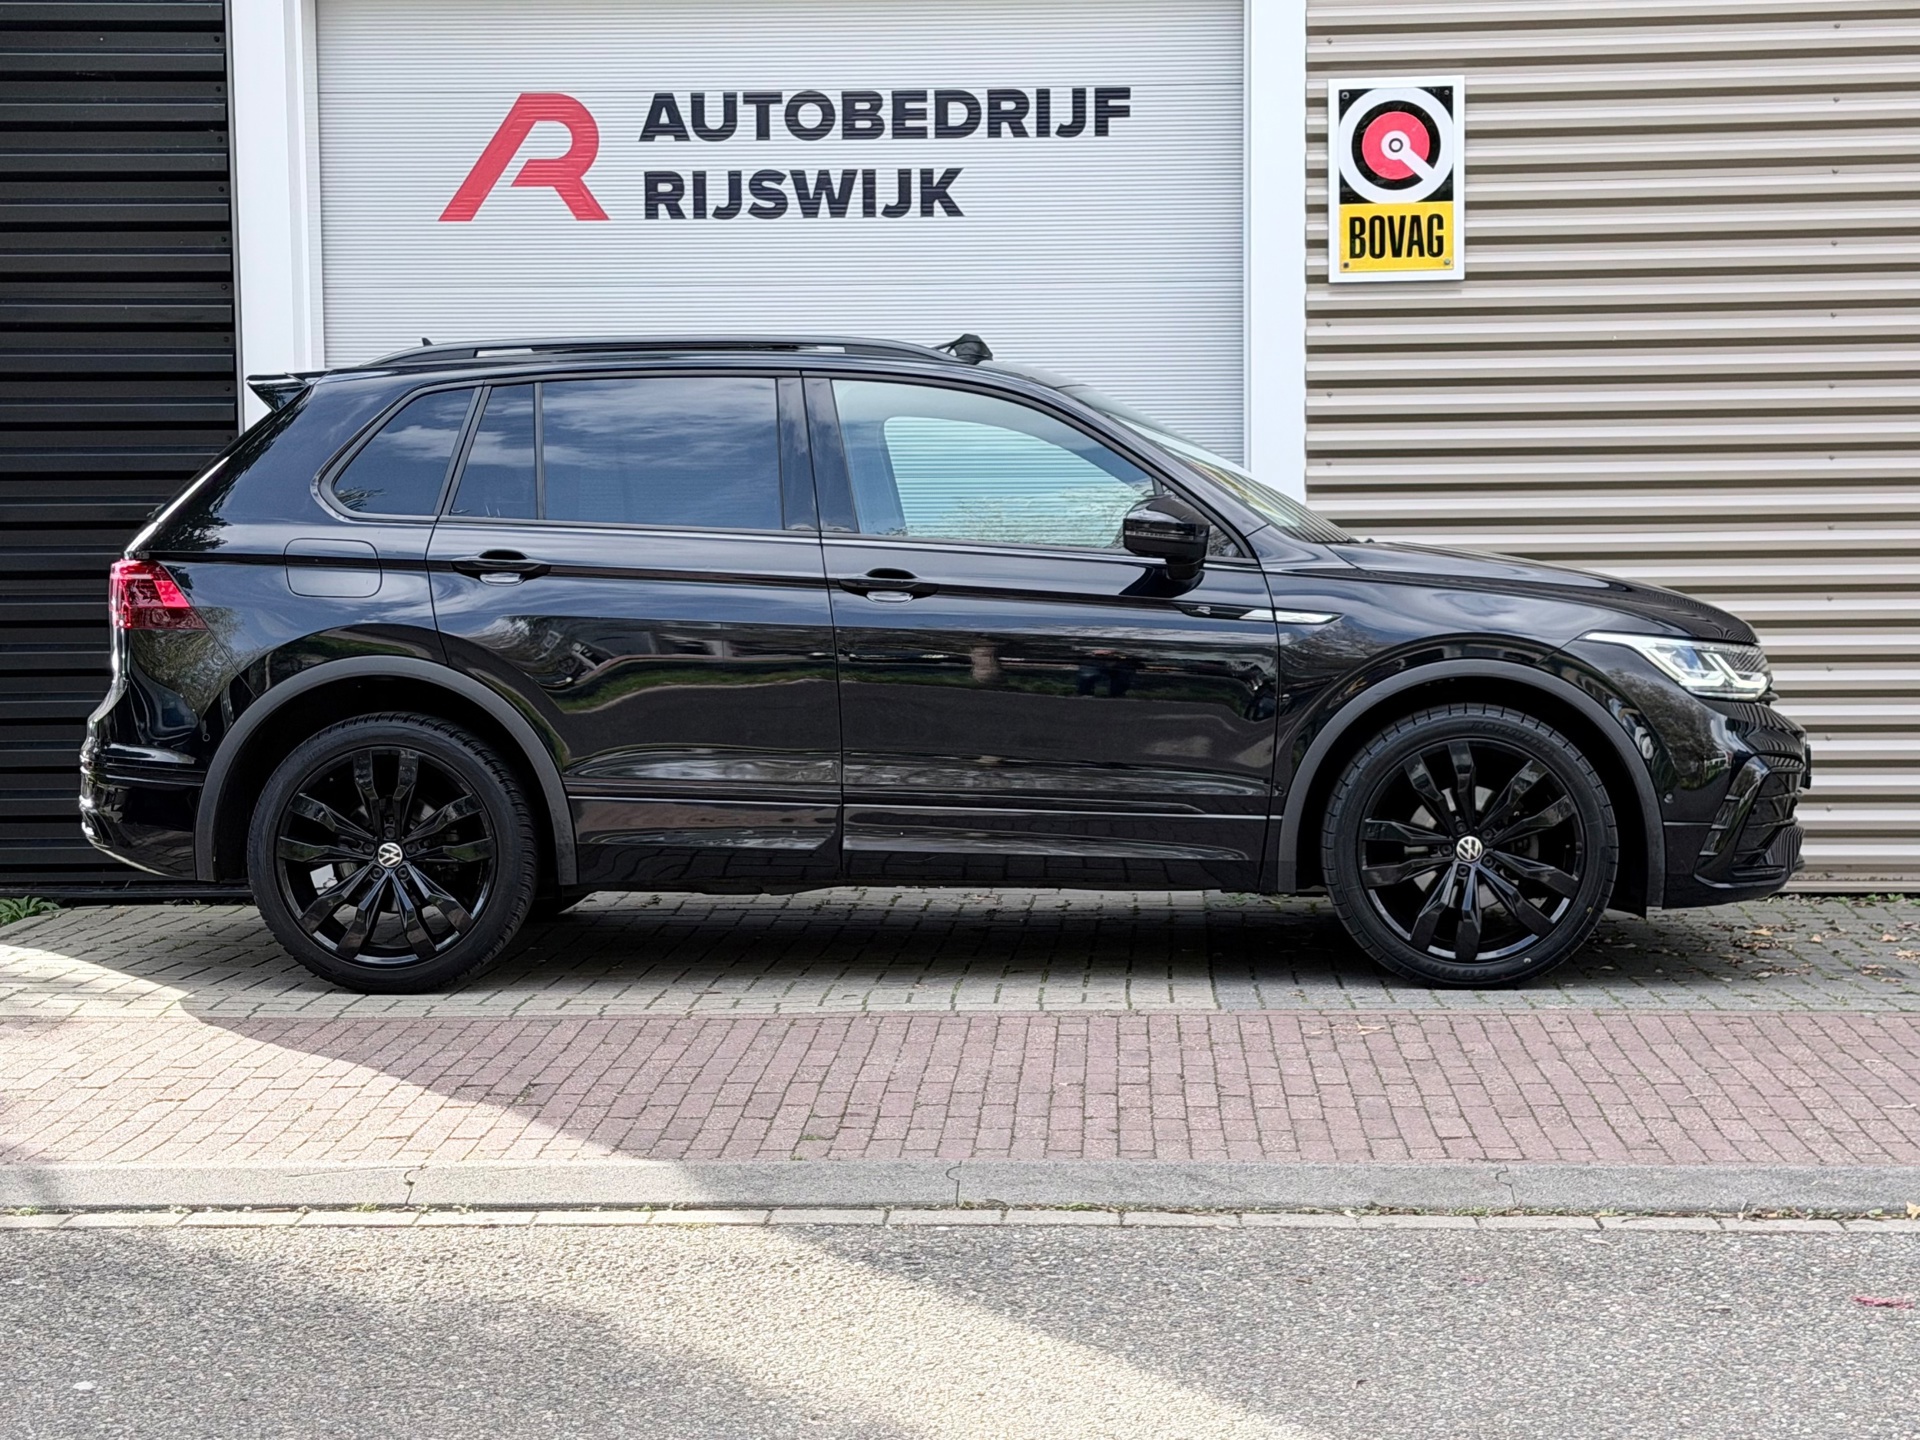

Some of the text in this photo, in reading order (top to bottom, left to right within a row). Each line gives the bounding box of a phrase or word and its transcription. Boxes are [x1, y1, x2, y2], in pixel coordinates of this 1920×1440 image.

[639, 86, 1131, 142] AUTOBEDRIJF
[643, 167, 965, 220] RIJSWIJK
[1349, 213, 1444, 259] BOVAG
